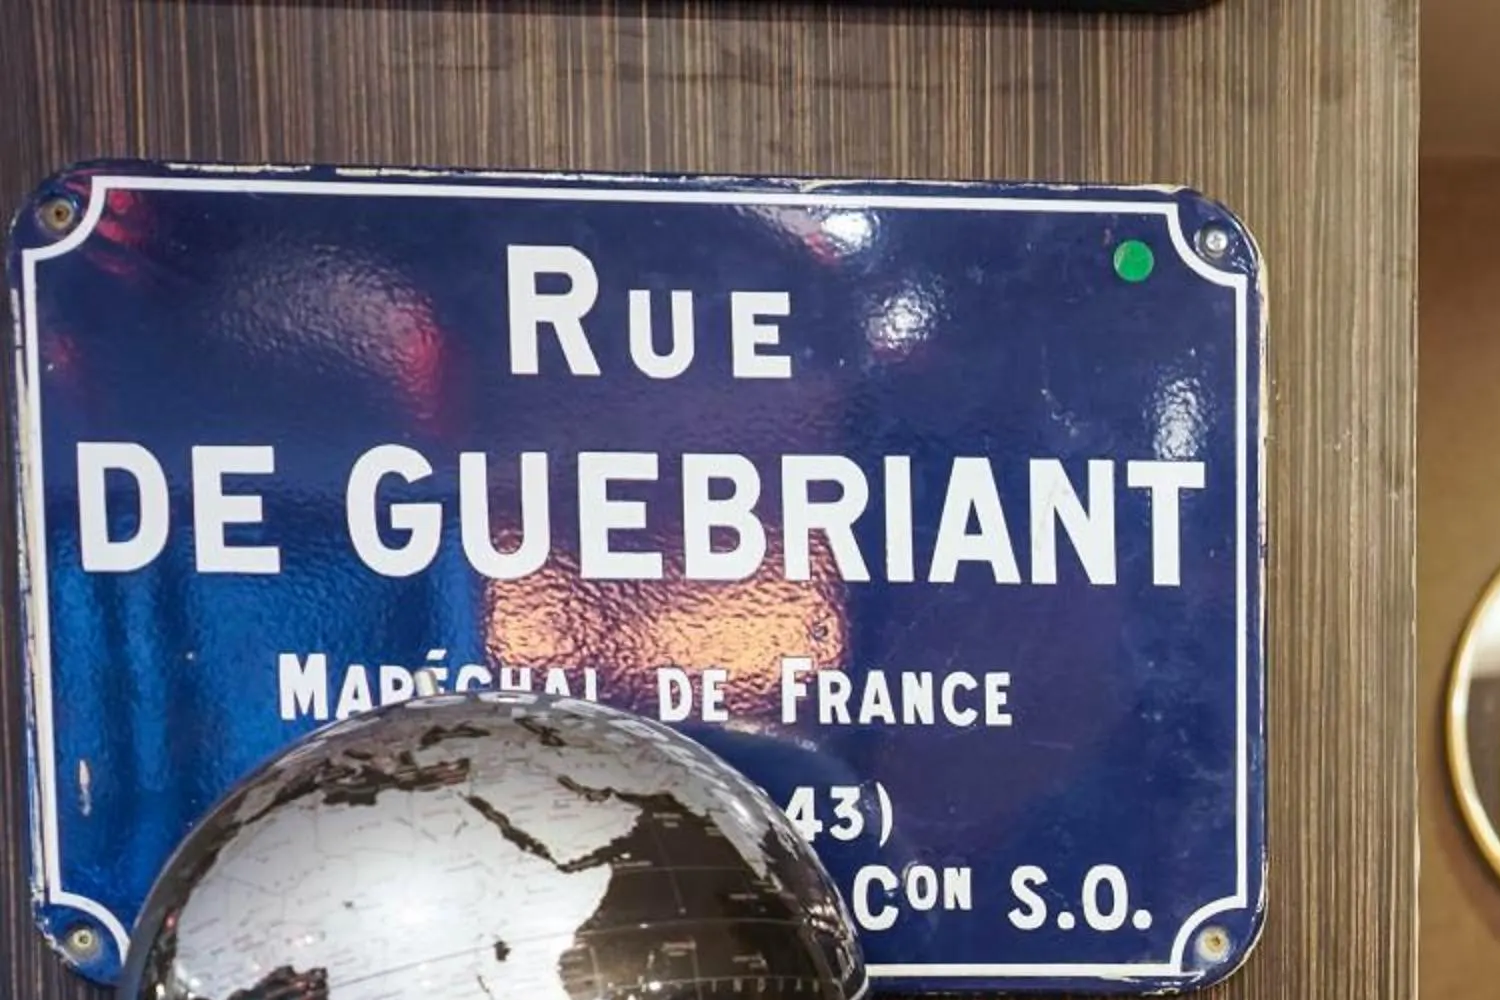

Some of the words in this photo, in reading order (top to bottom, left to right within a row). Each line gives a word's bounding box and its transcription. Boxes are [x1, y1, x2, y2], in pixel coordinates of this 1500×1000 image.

[507, 244, 792, 380] RUE
[77, 441, 281, 574] DE
[346, 444, 1206, 587] GUEBRIANT
[657, 667, 730, 722] DE
[781, 656, 1013, 727] FRANCE
[1007, 864, 1153, 931] S.O.
